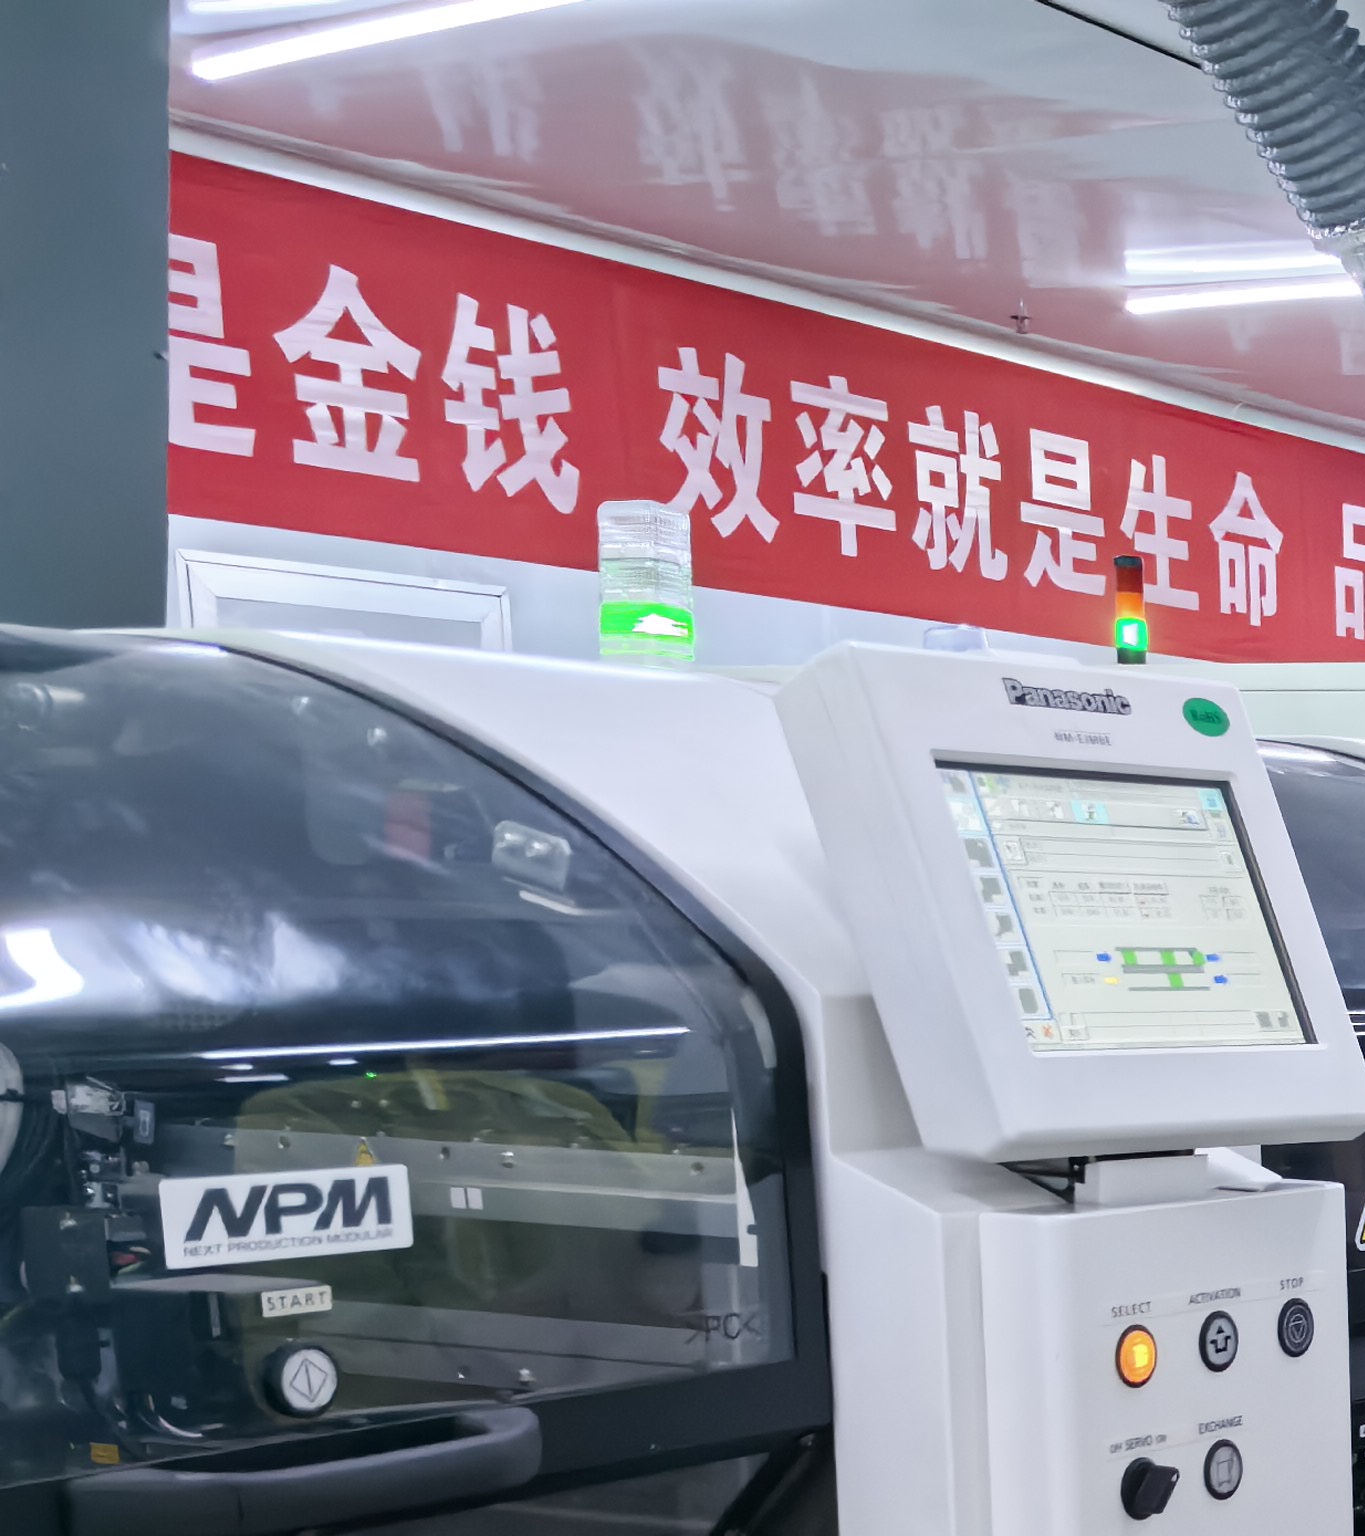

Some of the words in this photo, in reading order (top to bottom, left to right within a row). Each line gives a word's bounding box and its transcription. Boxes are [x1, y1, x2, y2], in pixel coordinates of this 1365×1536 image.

[657, 347, 1284, 627] 效率就是生命
[1001, 677, 1132, 716] Panasonic
[183, 1175, 393, 1244] NPM
[183, 1243, 223, 1258] NEXT
[227, 1234, 323, 1254] PRODUCTION
[325, 1227, 395, 1245] MODULAR
[1279, 1276, 1305, 1291] STOP
[265, 1291, 328, 1312] START
[1188, 1287, 1242, 1306] ACTIVATION
[1111, 1301, 1153, 1318] SELECT
[1124, 1434, 1153, 1452] SERVO
